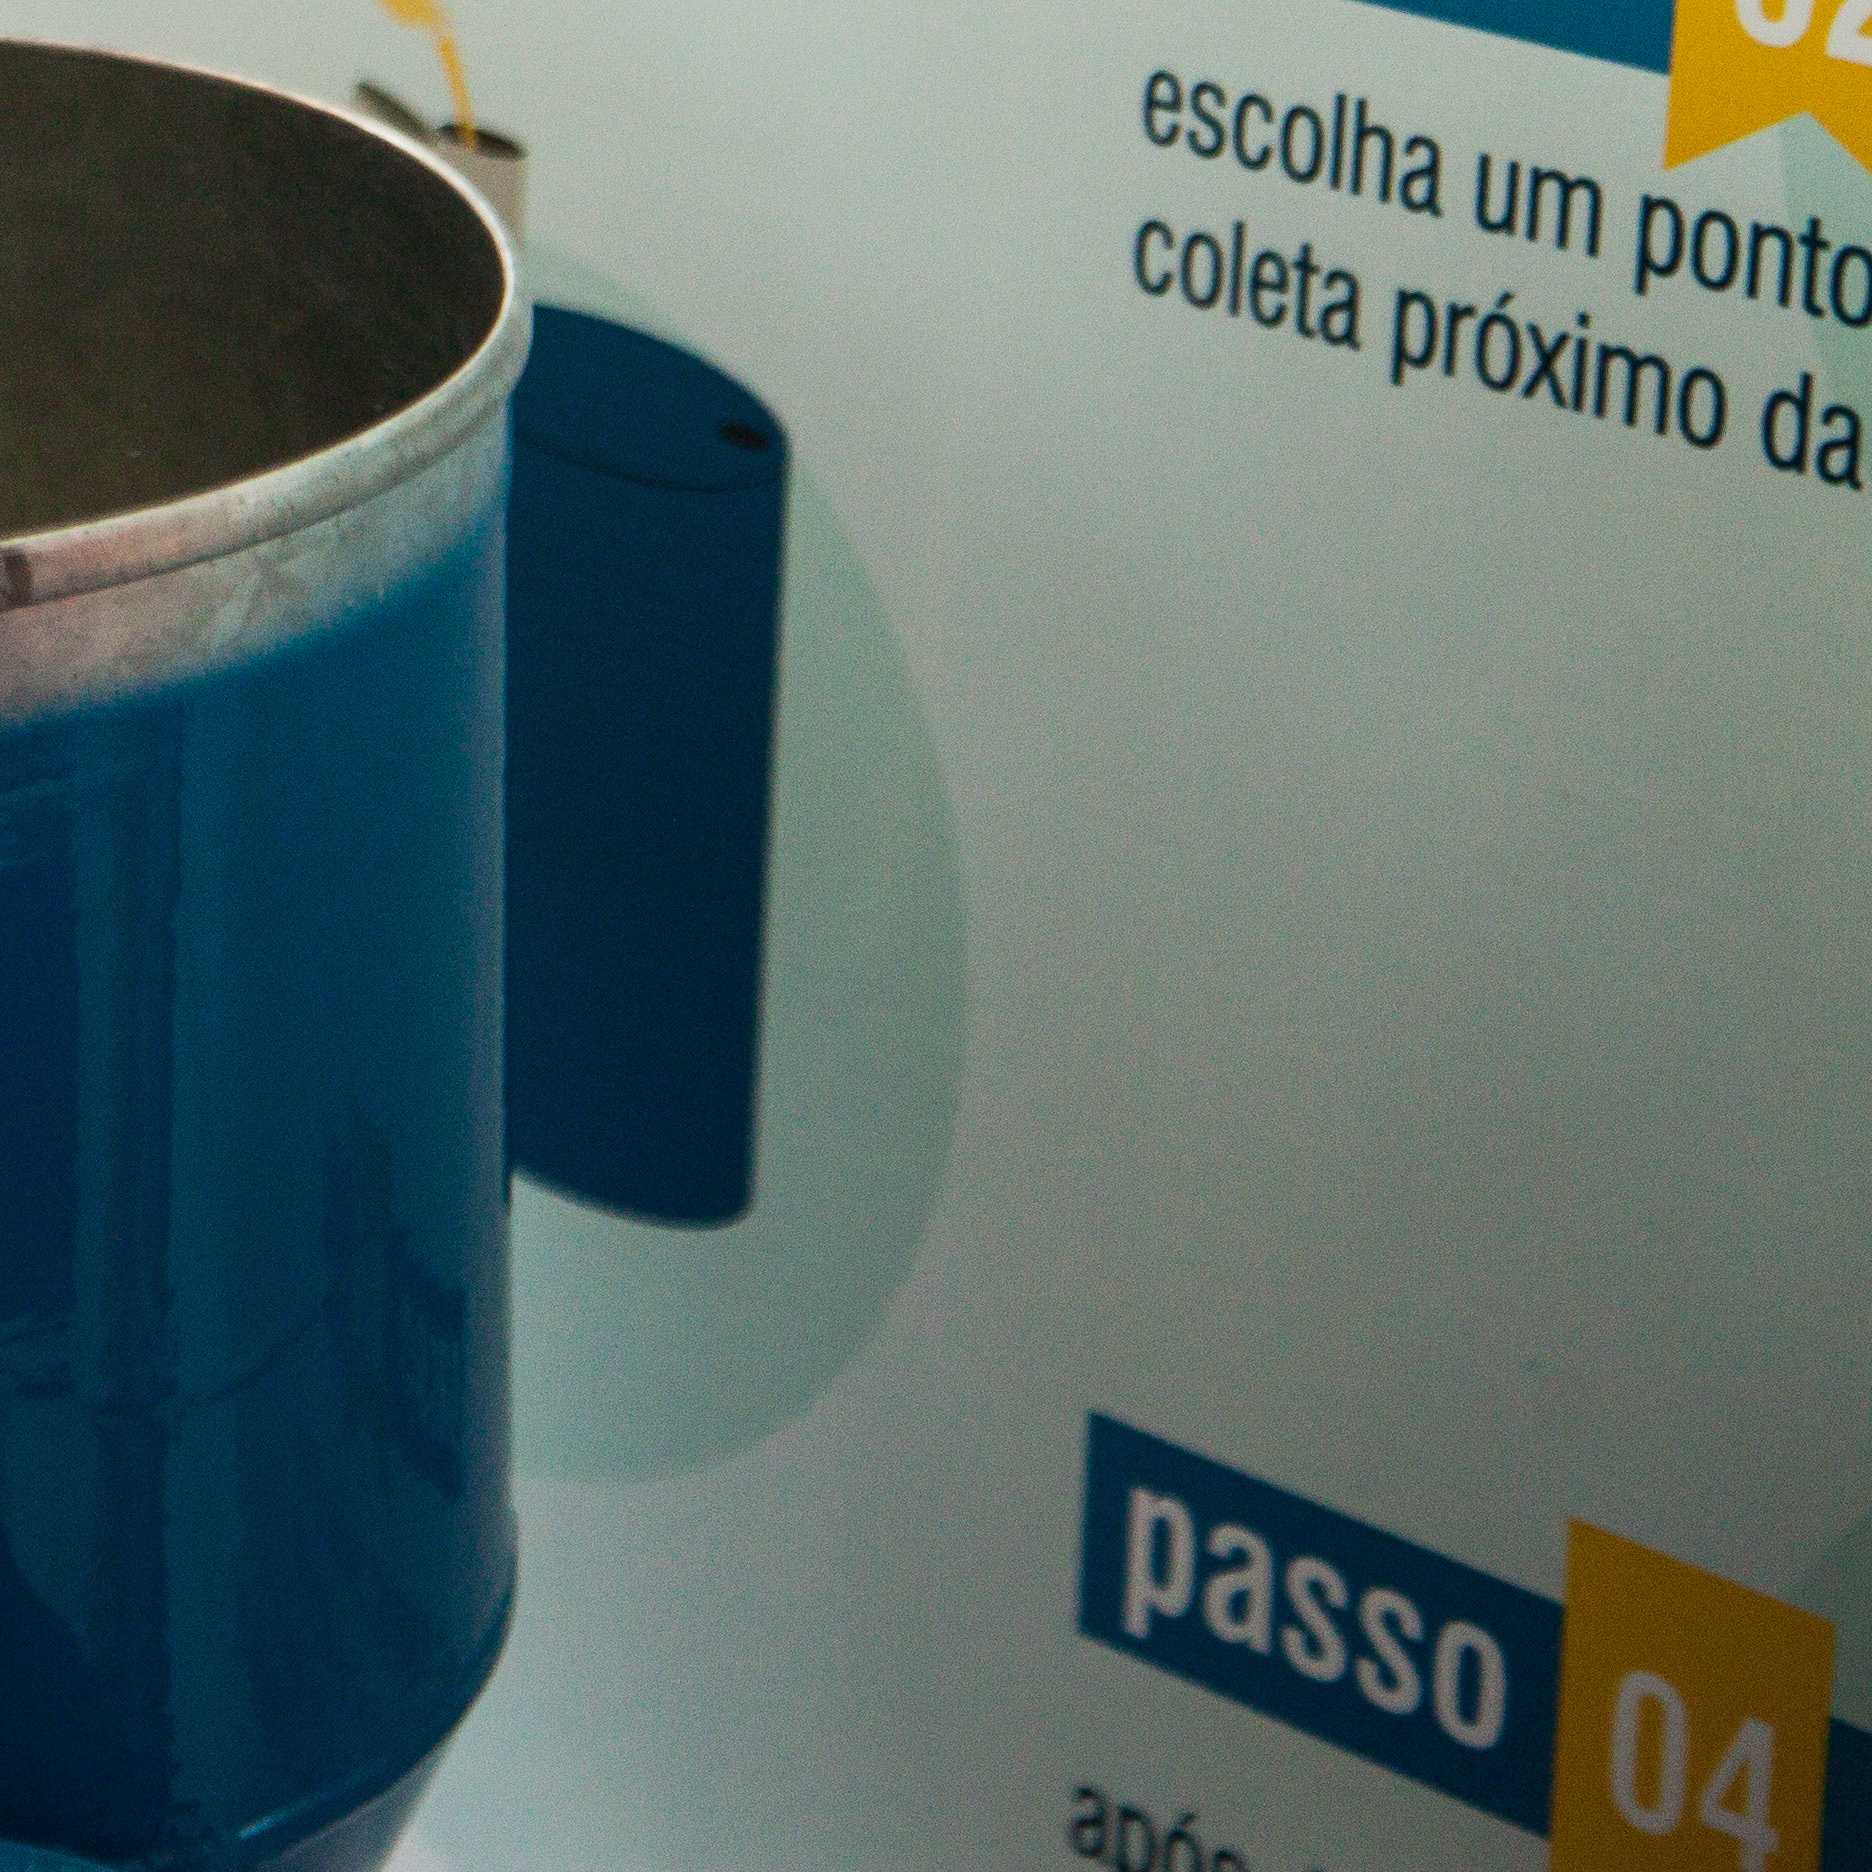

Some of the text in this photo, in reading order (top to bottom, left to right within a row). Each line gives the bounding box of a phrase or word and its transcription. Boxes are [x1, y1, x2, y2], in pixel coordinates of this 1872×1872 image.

[1140, 68, 1872, 328] escolha um ponto
[1132, 217, 1865, 491] coleta próximo da
[1122, 1485, 1779, 1872] passo 04
